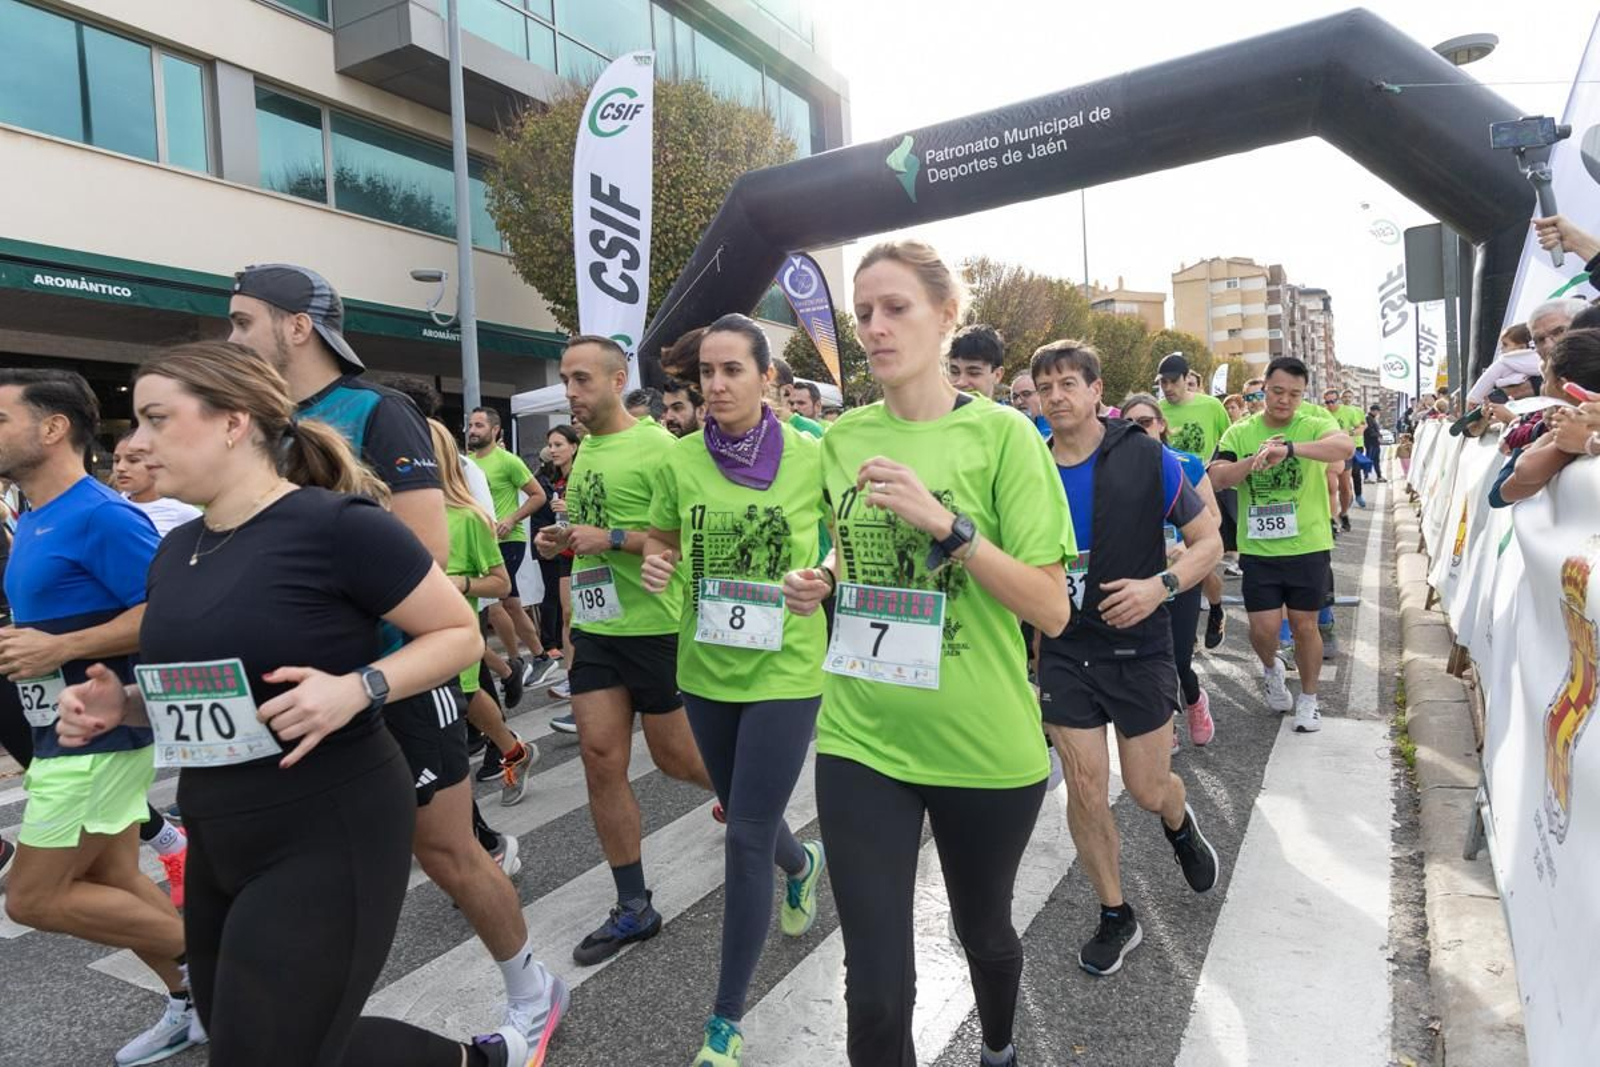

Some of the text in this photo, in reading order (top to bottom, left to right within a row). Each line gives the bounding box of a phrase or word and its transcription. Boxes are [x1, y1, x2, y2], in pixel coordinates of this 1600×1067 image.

[600, 103, 644, 121] CSIF
[925, 106, 1112, 165] Patronato Municipal de
[927, 137, 1068, 183] Deportes de Jaén
[589, 172, 641, 305] CSIF
[690, 504, 706, 530] 17
[1256, 516, 1286, 532] 358
[854, 531, 905, 542] CARREA
[578, 587, 605, 610] 198
[704, 580, 720, 596] XI
[841, 586, 857, 609] XI
[729, 605, 746, 630] 8
[870, 622, 889, 658] 7
[141, 670, 164, 694] XI
[21, 684, 50, 710] 52
[166, 702, 236, 742] 270
